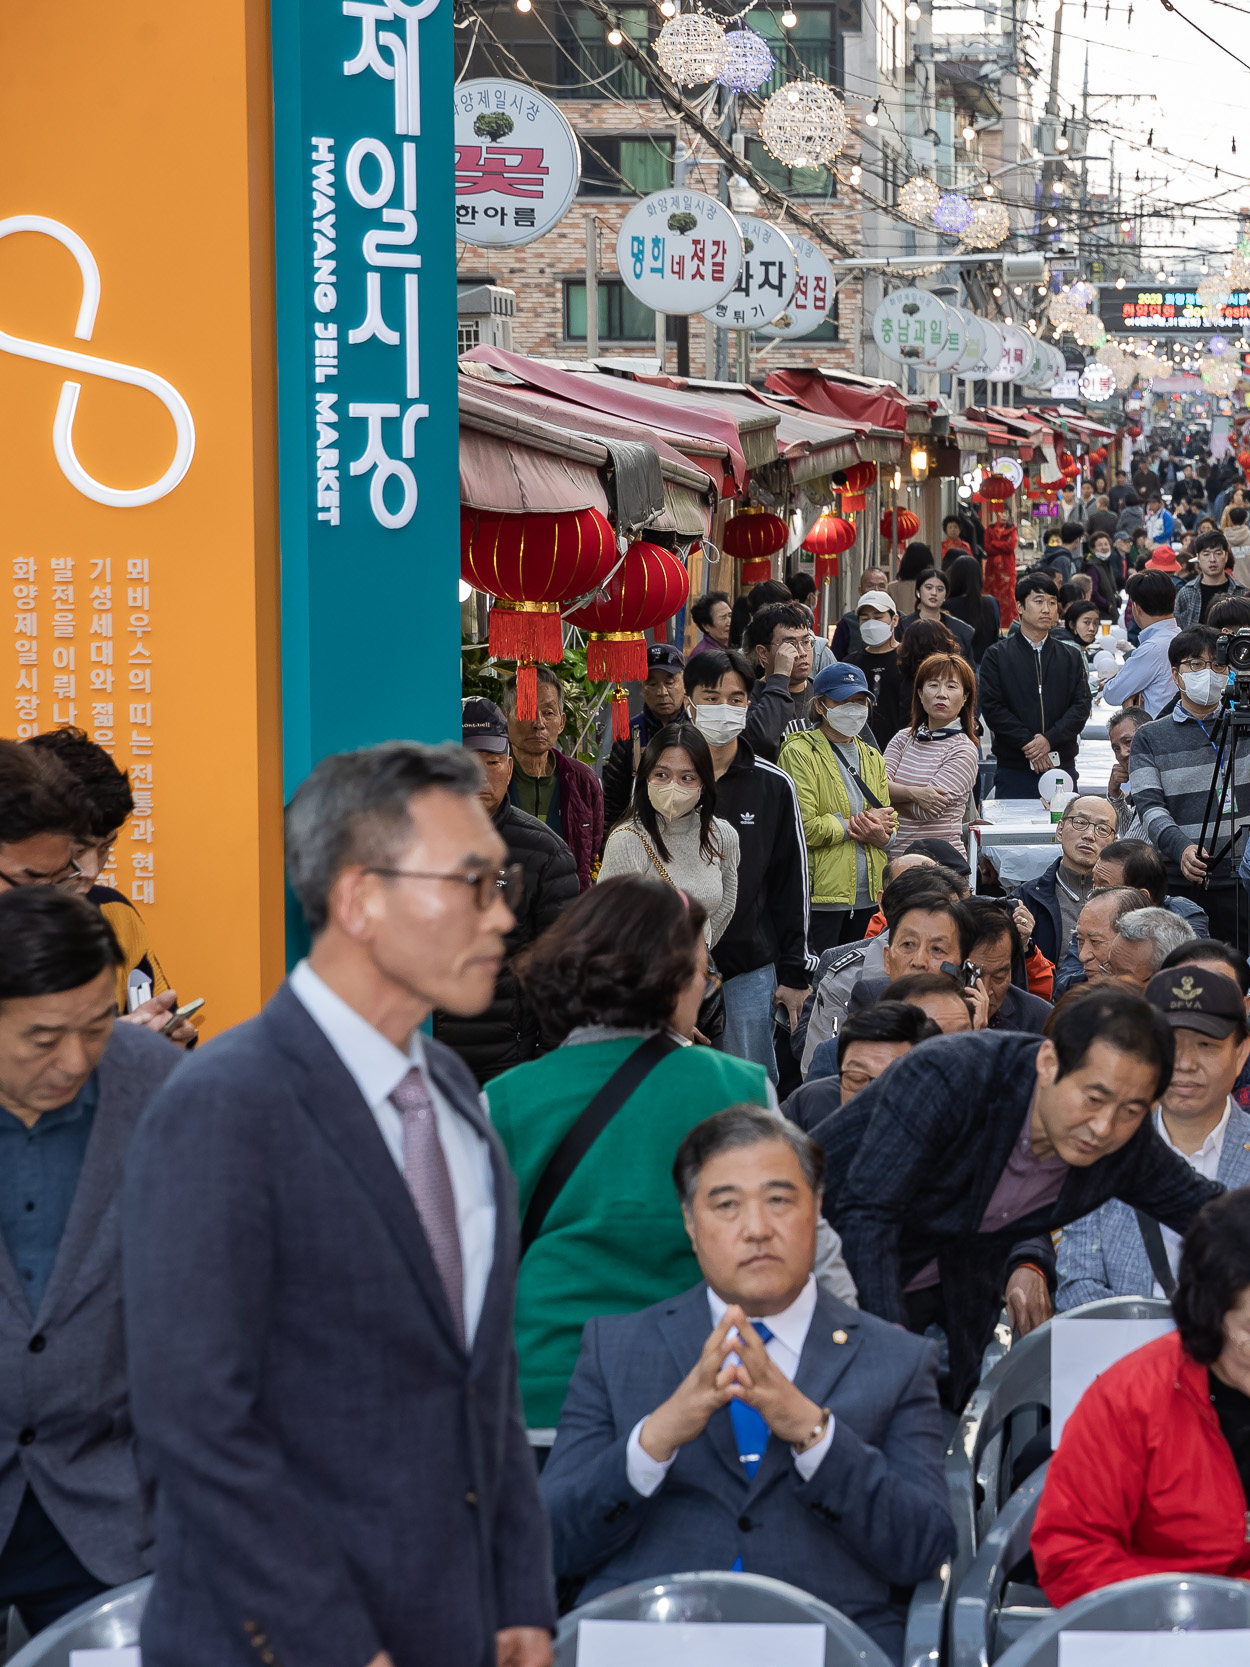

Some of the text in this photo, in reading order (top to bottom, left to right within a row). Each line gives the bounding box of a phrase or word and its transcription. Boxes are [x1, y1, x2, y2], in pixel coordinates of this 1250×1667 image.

[456, 204, 536, 227] 한아름
[631, 235, 728, 283] 명희네젓갈
[646, 195, 718, 221] 화양제일시장
[342, 0, 441, 529] 제일시장
[311, 136, 340, 526] HWAYANG JEIL MARKET
[50, 557, 77, 638] 발전을
[89, 557, 116, 693] 기성세대와
[126, 557, 155, 904] 뫼비우스의 띠는 전통과 현대
